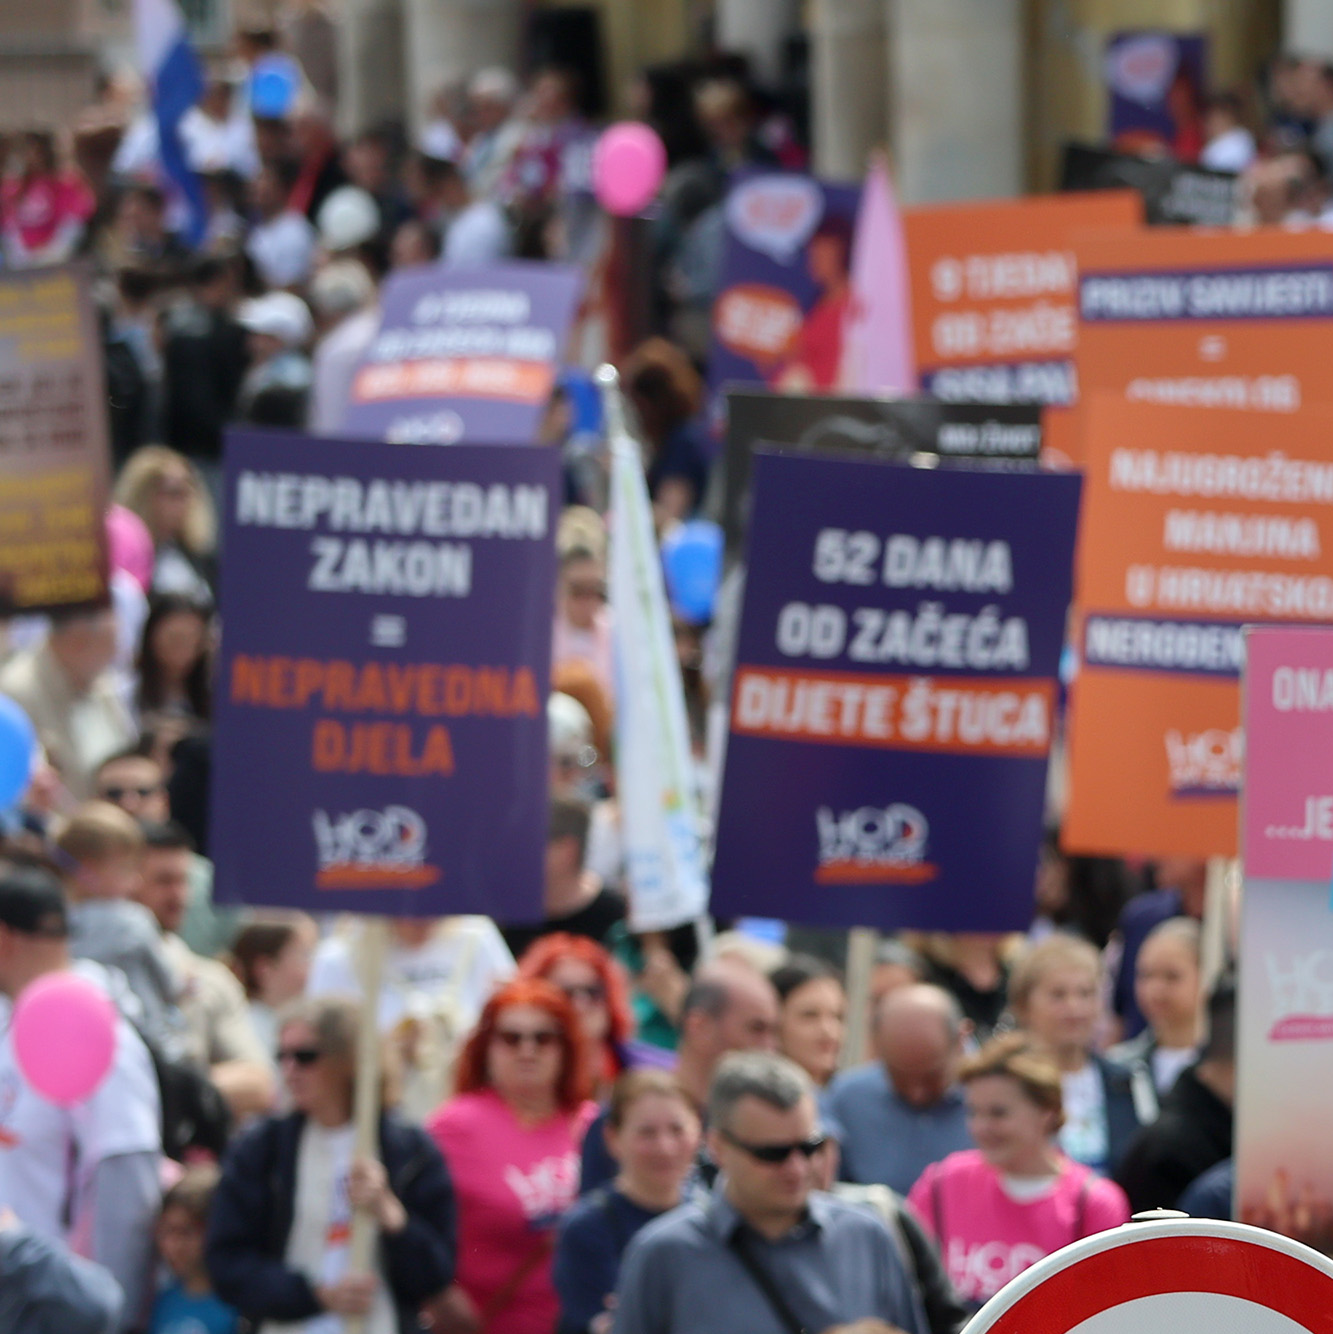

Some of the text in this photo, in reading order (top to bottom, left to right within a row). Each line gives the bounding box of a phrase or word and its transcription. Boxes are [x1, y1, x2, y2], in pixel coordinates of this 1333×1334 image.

[236, 470, 549, 541] NEPRAVEDAN
[1163, 509, 1321, 560] MANJINA
[308, 536, 472, 598] ZAKON
[813, 527, 1013, 594] 52 DANA
[1125, 564, 1156, 608] U
[776, 601, 1030, 671] OD ZAČEĆA
[230, 653, 540, 719] NEPRAVEDNA
[736, 673, 1050, 746] DIJETE ŠTUCA
[312, 719, 455, 778] DJELA
